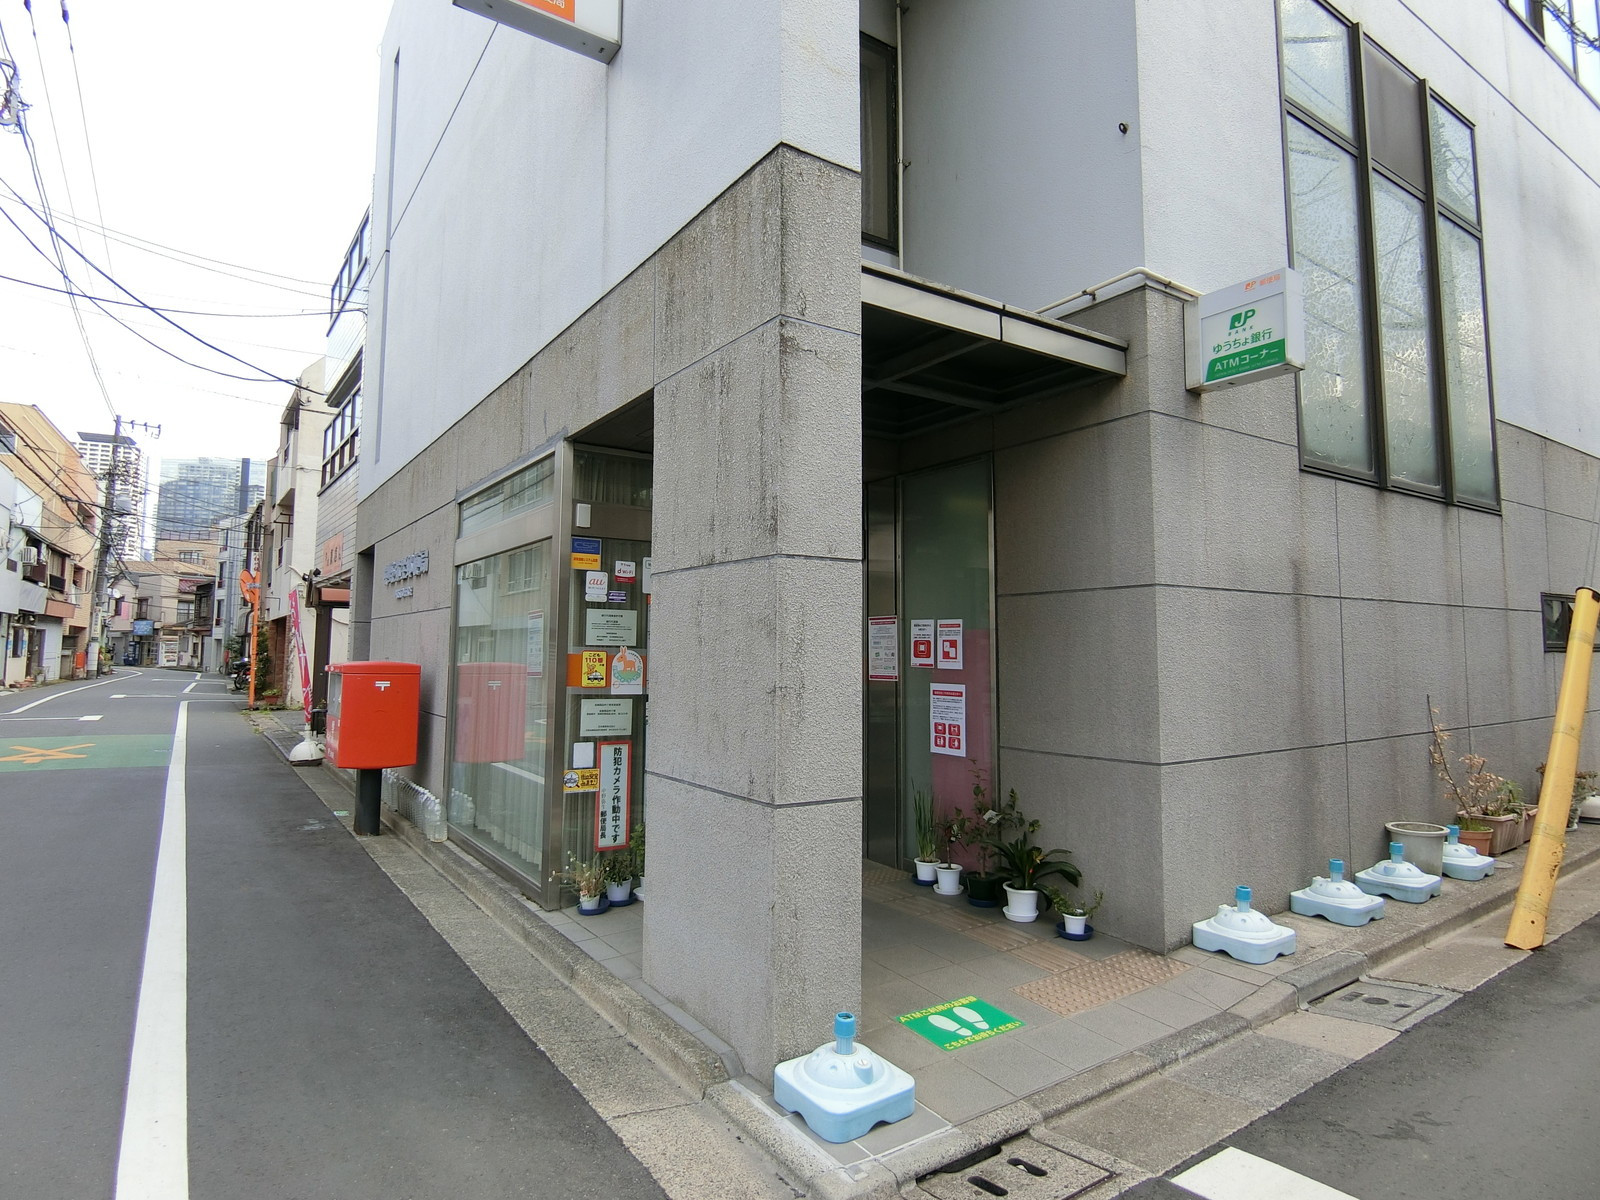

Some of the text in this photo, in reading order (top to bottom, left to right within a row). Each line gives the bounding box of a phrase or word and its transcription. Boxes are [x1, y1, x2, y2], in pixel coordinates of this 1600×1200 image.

[1227, 325, 1255, 337] BANK
[1228, 308, 1256, 331] JP
[1212, 327, 1273, 354] ゆうちょ銀行
[1214, 348, 1280, 372] ATMコーナー
[588, 578, 606, 586] au
[611, 746, 623, 844] 防犯カメラ作動中です
[899, 995, 977, 1022] ATMご利用のお客様
[944, 1021, 1022, 1050] こちらでお待ちください
